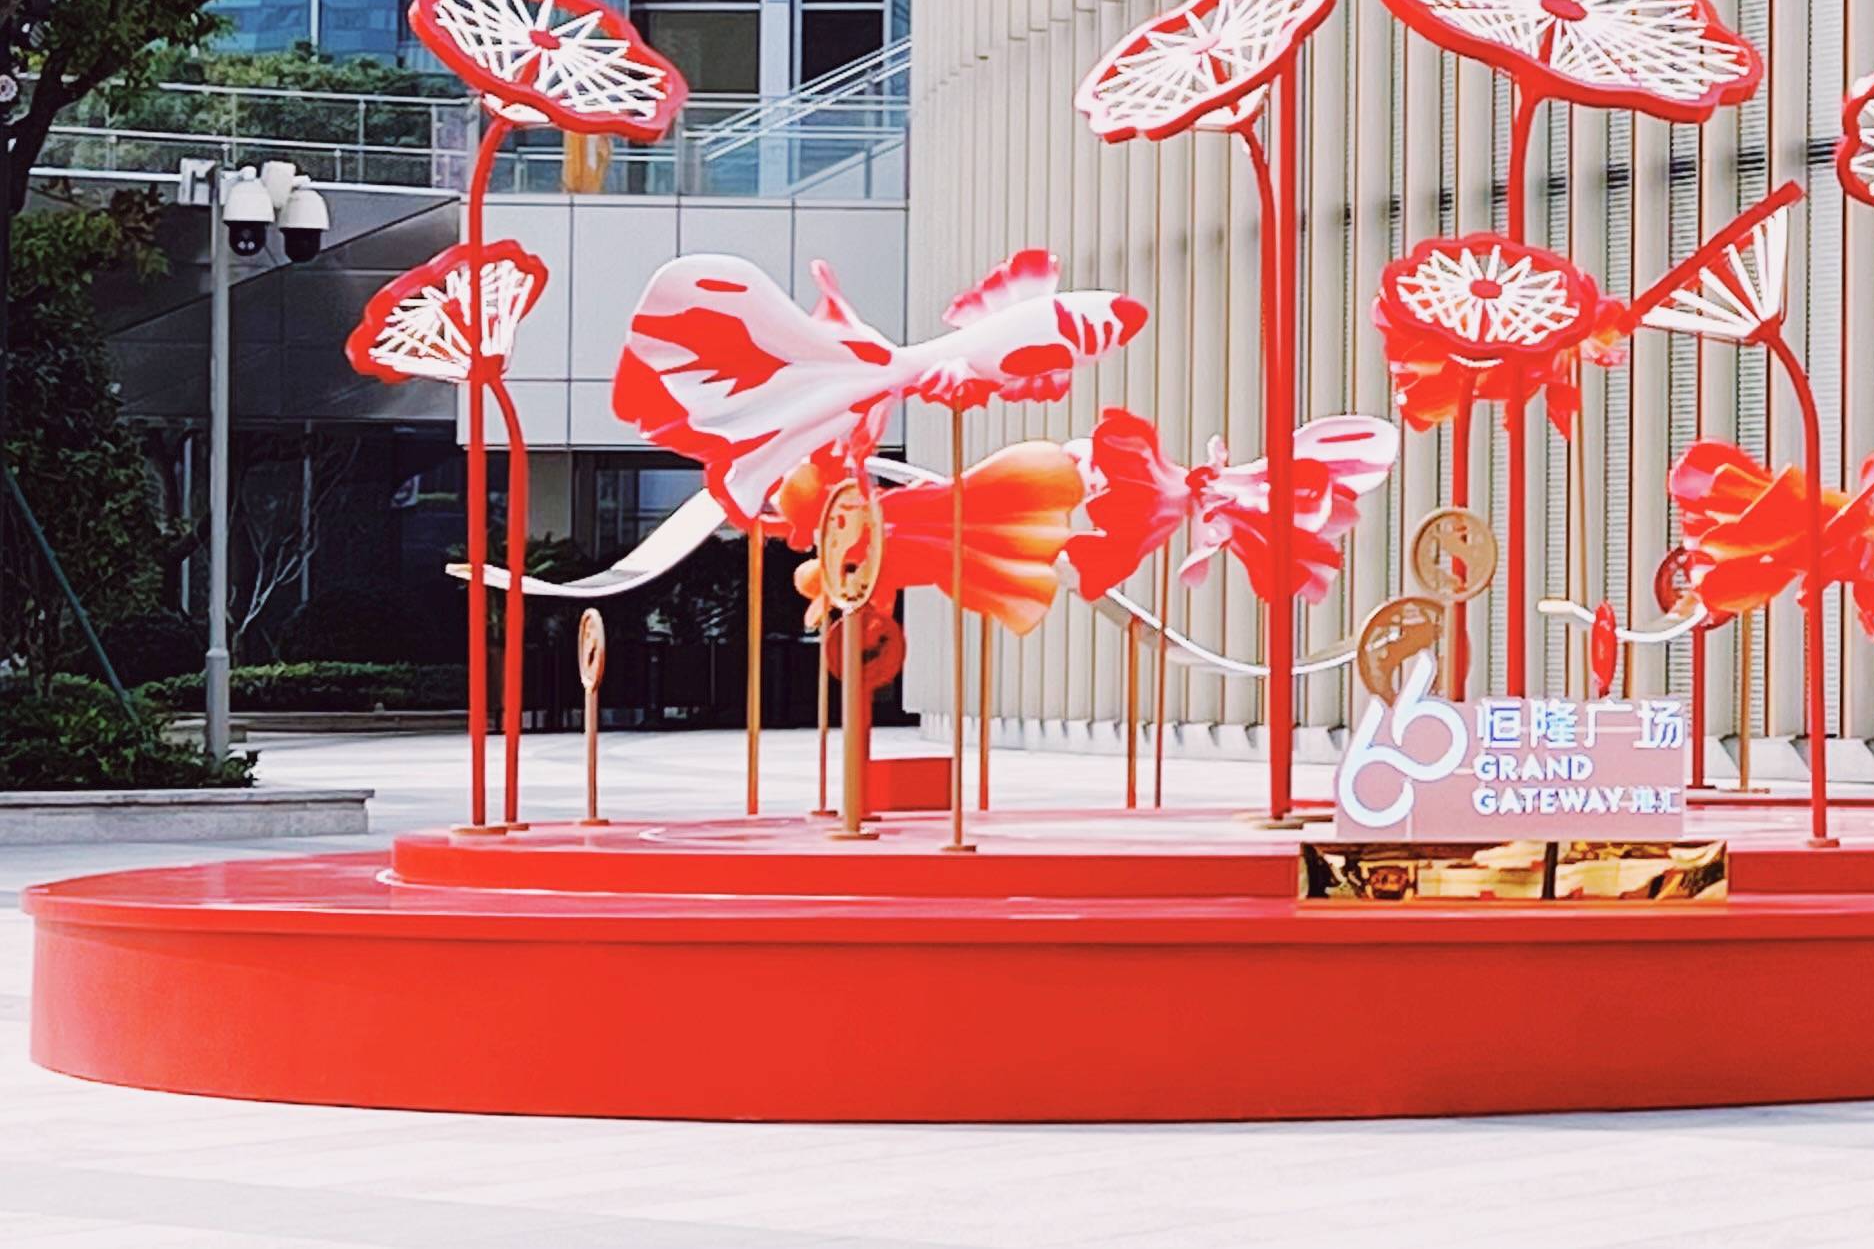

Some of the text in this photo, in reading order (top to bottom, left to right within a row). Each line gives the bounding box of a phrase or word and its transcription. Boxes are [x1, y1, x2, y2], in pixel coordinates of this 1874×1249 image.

[1474, 698, 1685, 749] 恒隆广场
[1472, 752, 1594, 782] GRAND
[1472, 785, 1625, 815] GATEWAY
